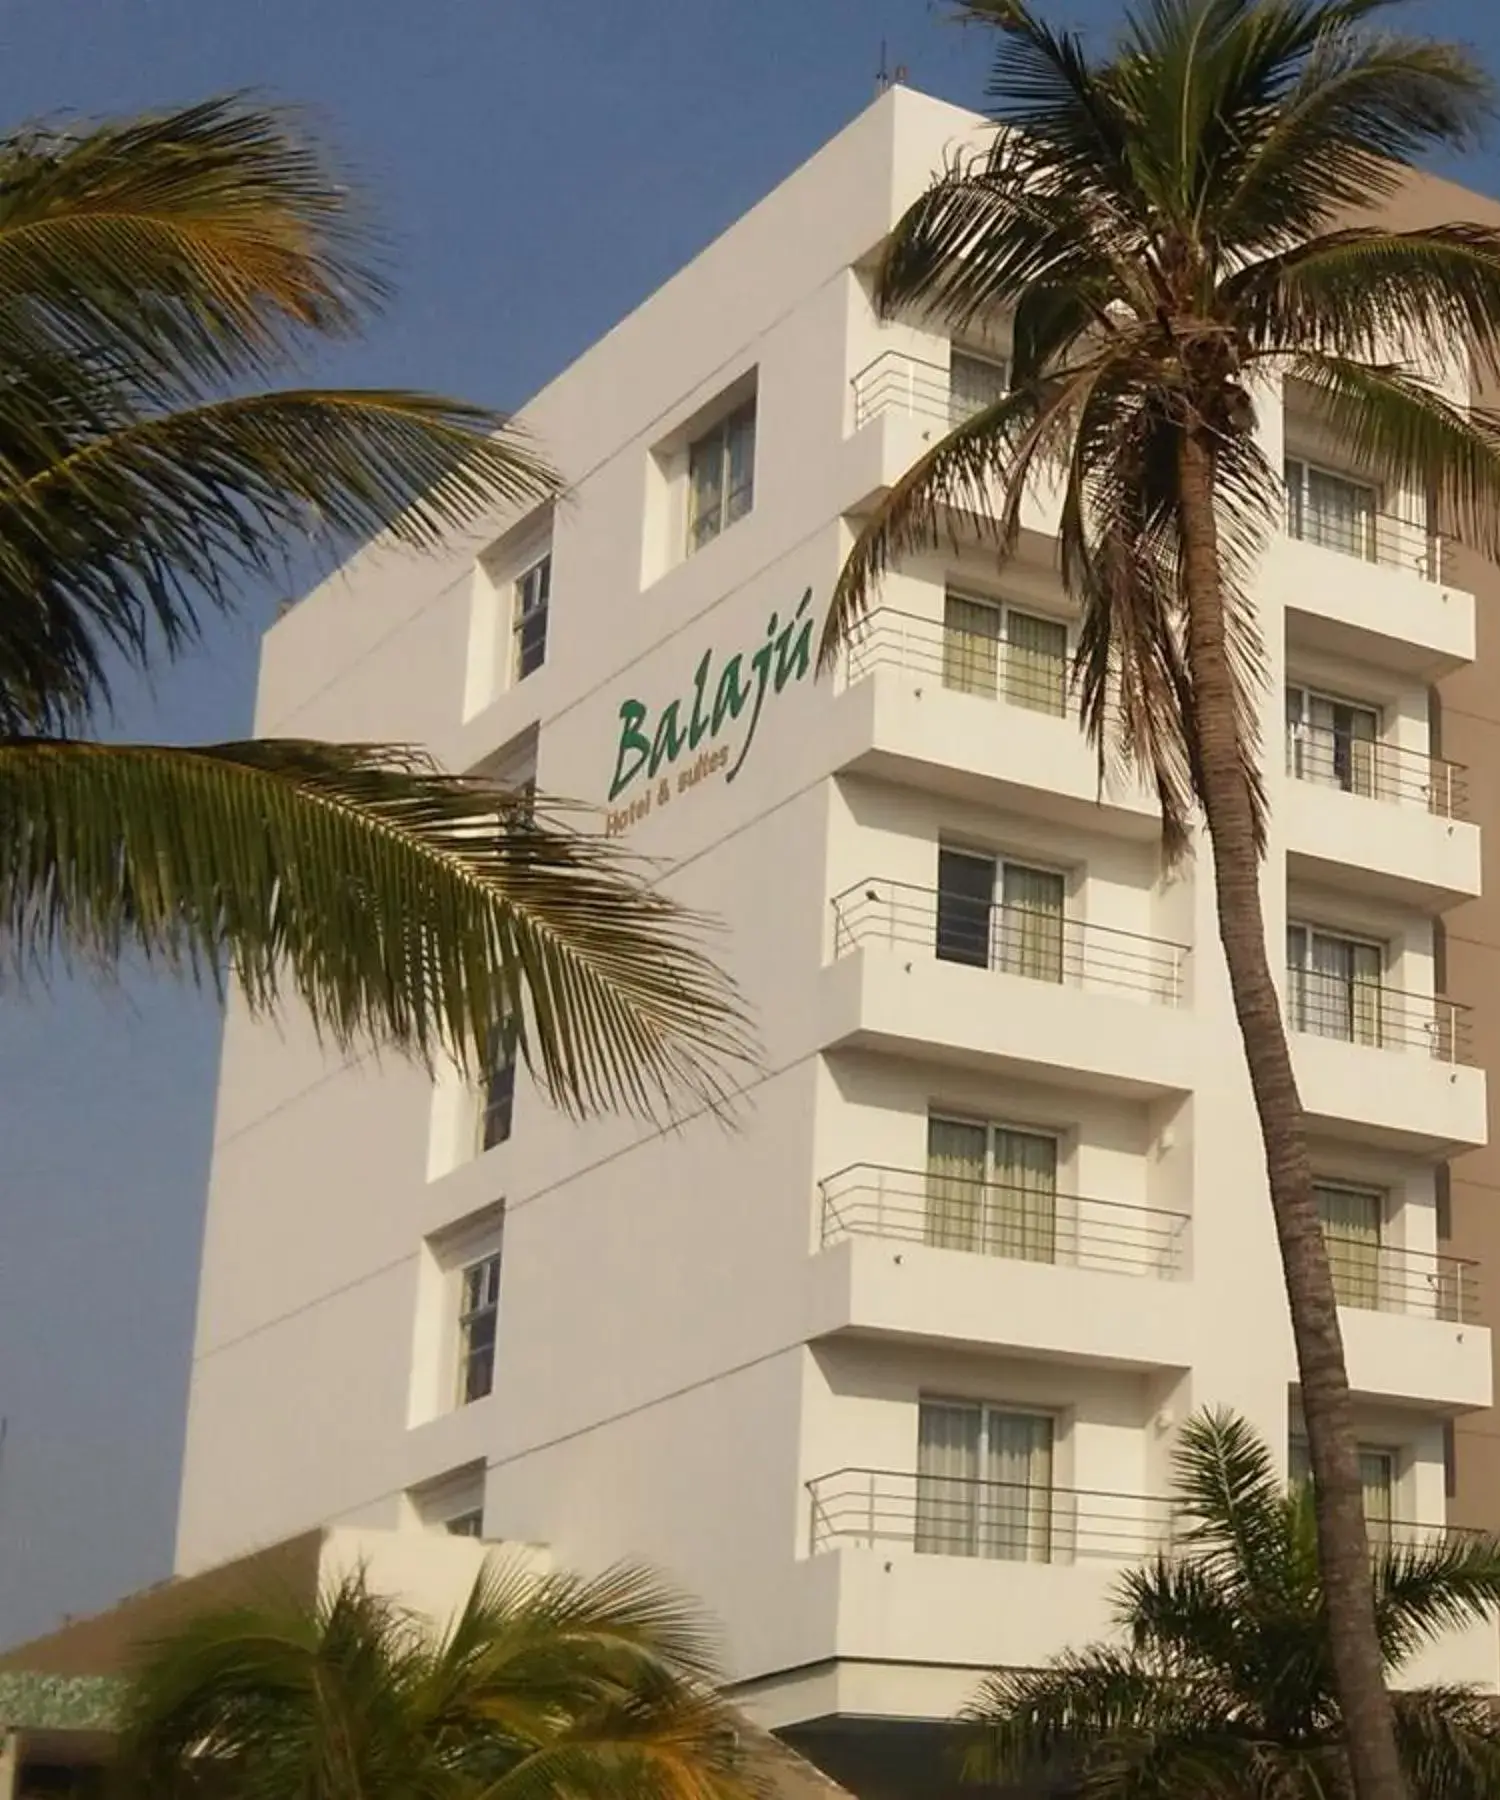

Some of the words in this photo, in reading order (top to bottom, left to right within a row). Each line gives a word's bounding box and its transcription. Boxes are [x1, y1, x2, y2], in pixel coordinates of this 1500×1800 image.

[608, 586, 813, 802] Balajú
[606, 788, 651, 838] Hotel
[656, 777, 670, 807] &
[677, 744, 729, 793] suites
